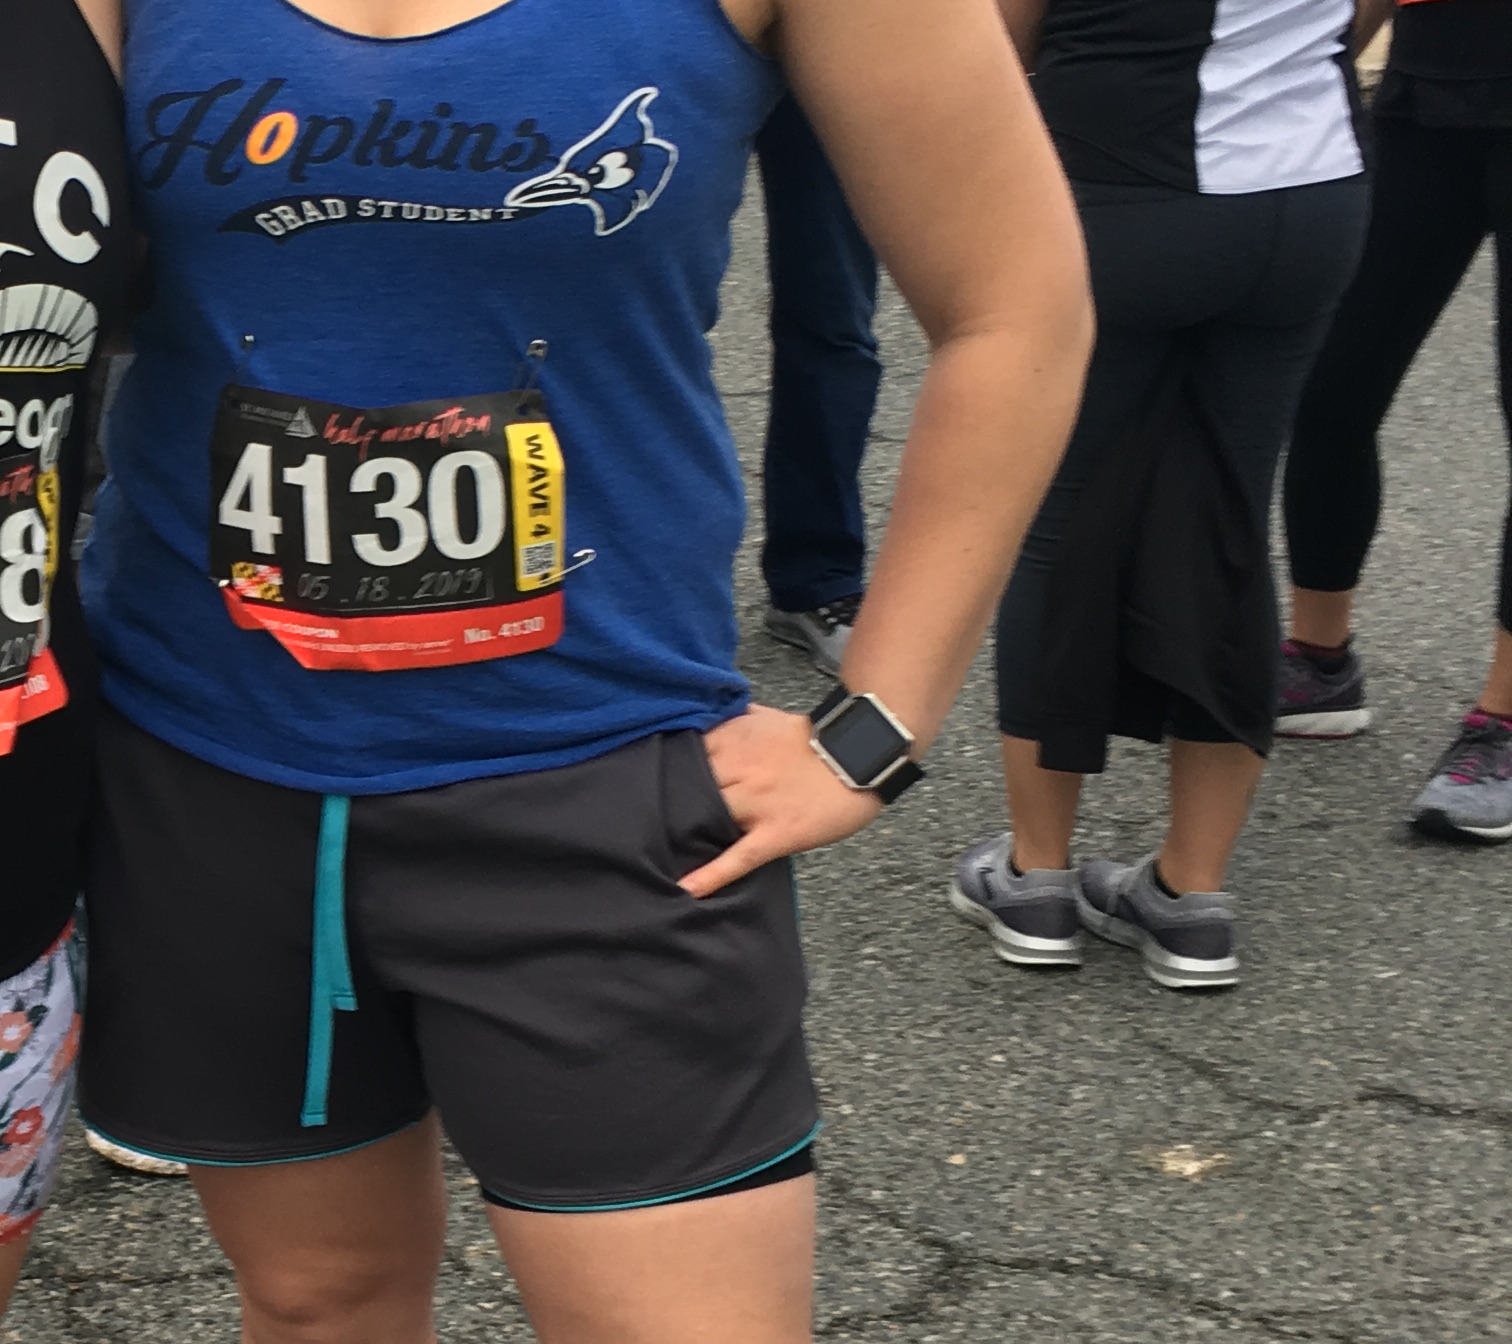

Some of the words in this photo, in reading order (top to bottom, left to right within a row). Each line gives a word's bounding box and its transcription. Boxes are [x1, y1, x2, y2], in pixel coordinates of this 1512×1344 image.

[137, 77, 560, 191] Hopkins
[254, 197, 348, 236] GRAD
[357, 199, 520, 222] STUDENT
[218, 441, 507, 567] 4130
[525, 433, 551, 517] WAVE
[530, 523, 552, 538] 4
